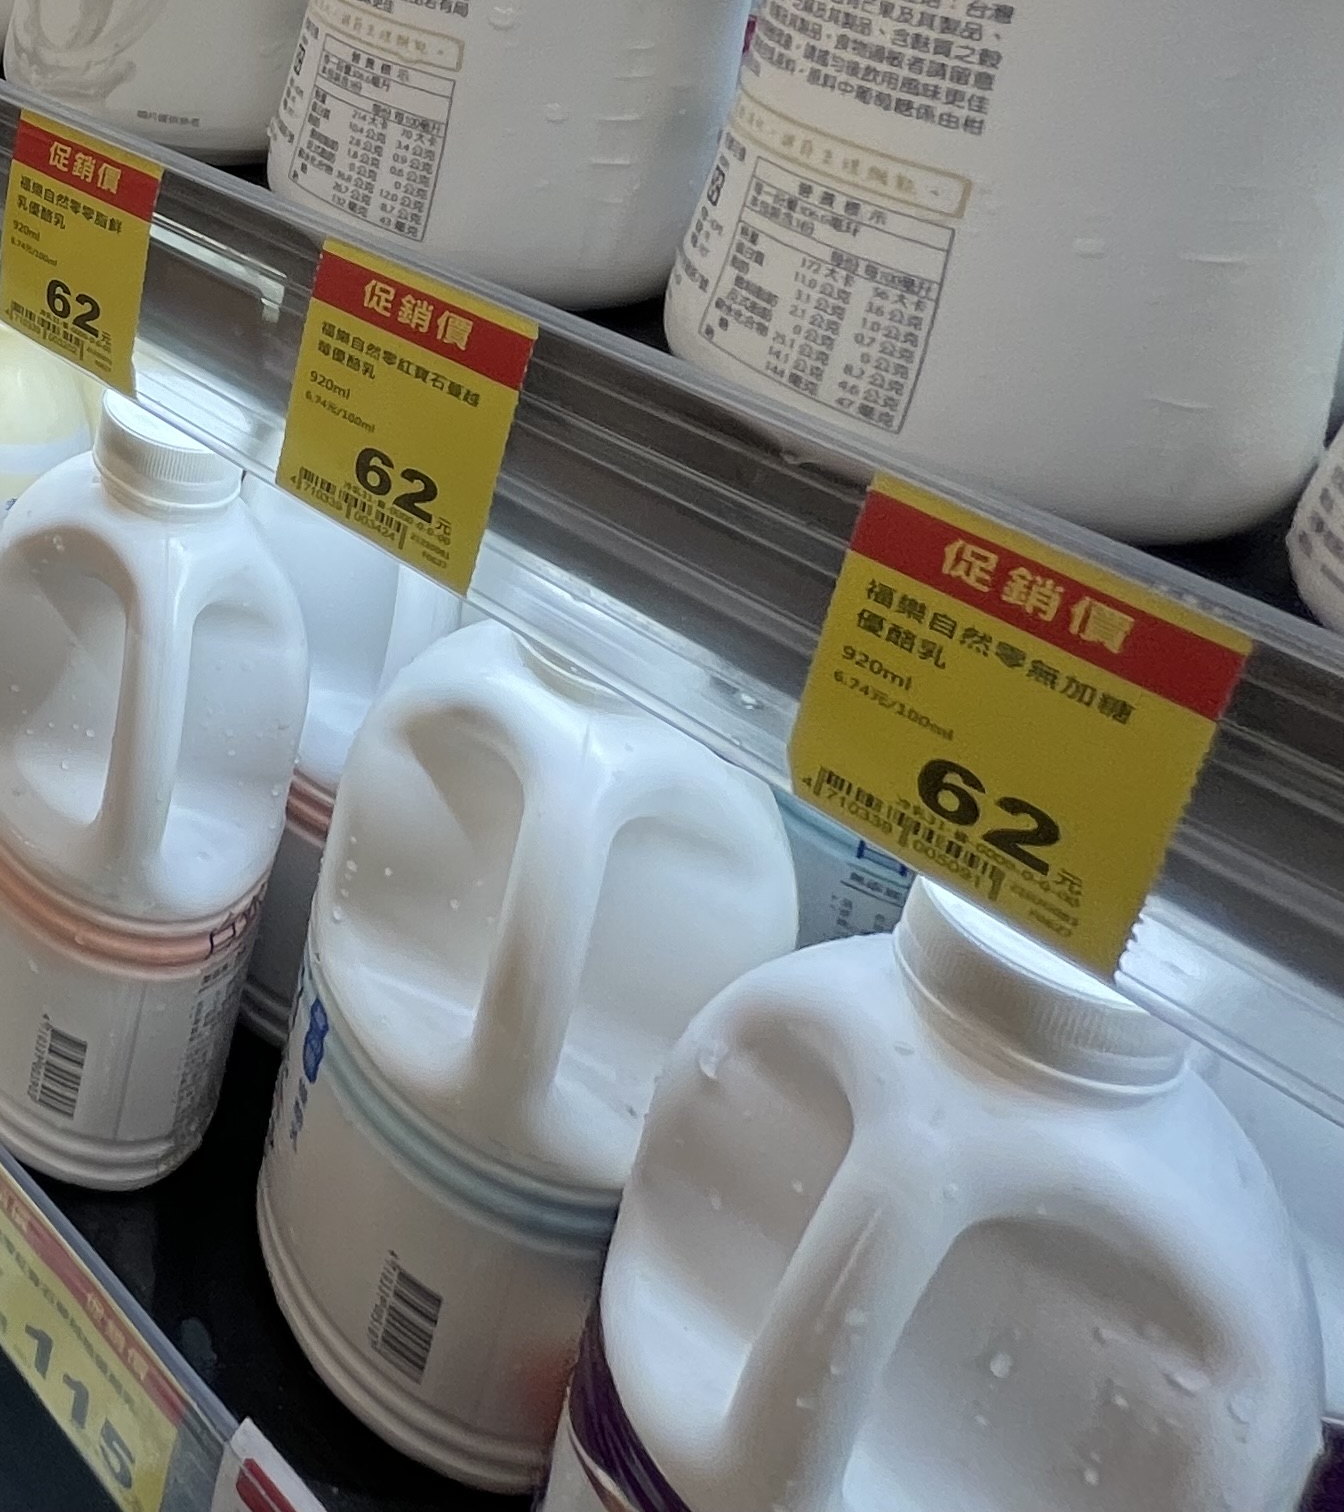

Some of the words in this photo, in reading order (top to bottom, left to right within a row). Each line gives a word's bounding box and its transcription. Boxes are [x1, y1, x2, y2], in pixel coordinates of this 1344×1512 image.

[48, 140, 123, 196] 促銷價
[13, 219, 41, 243] 920ml
[17, 194, 66, 230] 乳優酪乳
[20, 174, 123, 236] 福樂自然零零脂鮮
[379, 215, 391, 228] 43
[45, 278, 102, 340] 62
[100, 329, 113, 345] 元
[363, 279, 474, 352] 促銷價
[310, 370, 351, 401] 920ml
[317, 339, 376, 381] 莓優酪乳
[321, 320, 481, 409] 福樂自然零紅寶石蔓越
[355, 447, 439, 524] 62
[435, 517, 452, 537] 元
[940, 538, 1137, 656] 促銷價
[841, 644, 913, 692] 920ml
[855, 607, 948, 672] 優酪乳
[864, 576, 1137, 726] 福樂自然零無加糖
[833, 670, 955, 743] 6.74元/100ml
[916, 757, 1062, 878] 62
[1052, 868, 1084, 896] 元
[23, 1322, 137, 1491] 115
